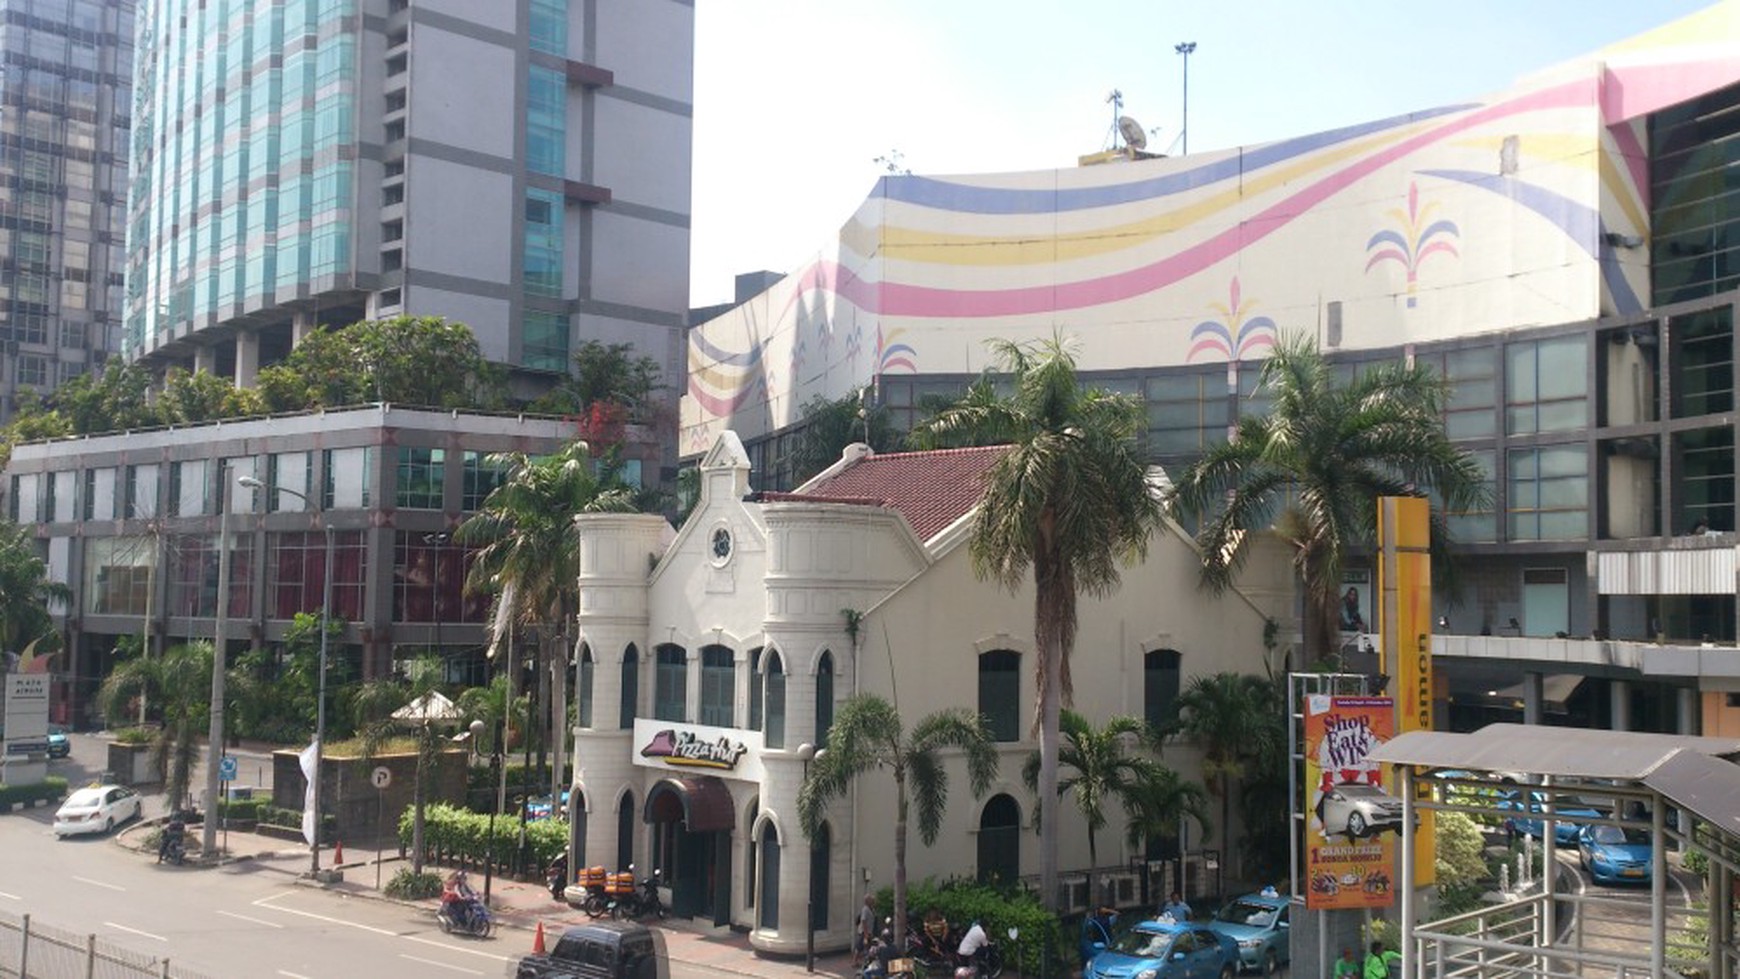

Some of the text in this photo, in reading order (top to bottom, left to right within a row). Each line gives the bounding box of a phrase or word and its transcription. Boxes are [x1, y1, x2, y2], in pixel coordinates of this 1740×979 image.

[1323, 714, 1370, 734] Shop
[672, 732, 748, 764] Pizza Hut
[1311, 848, 1319, 864] 1
